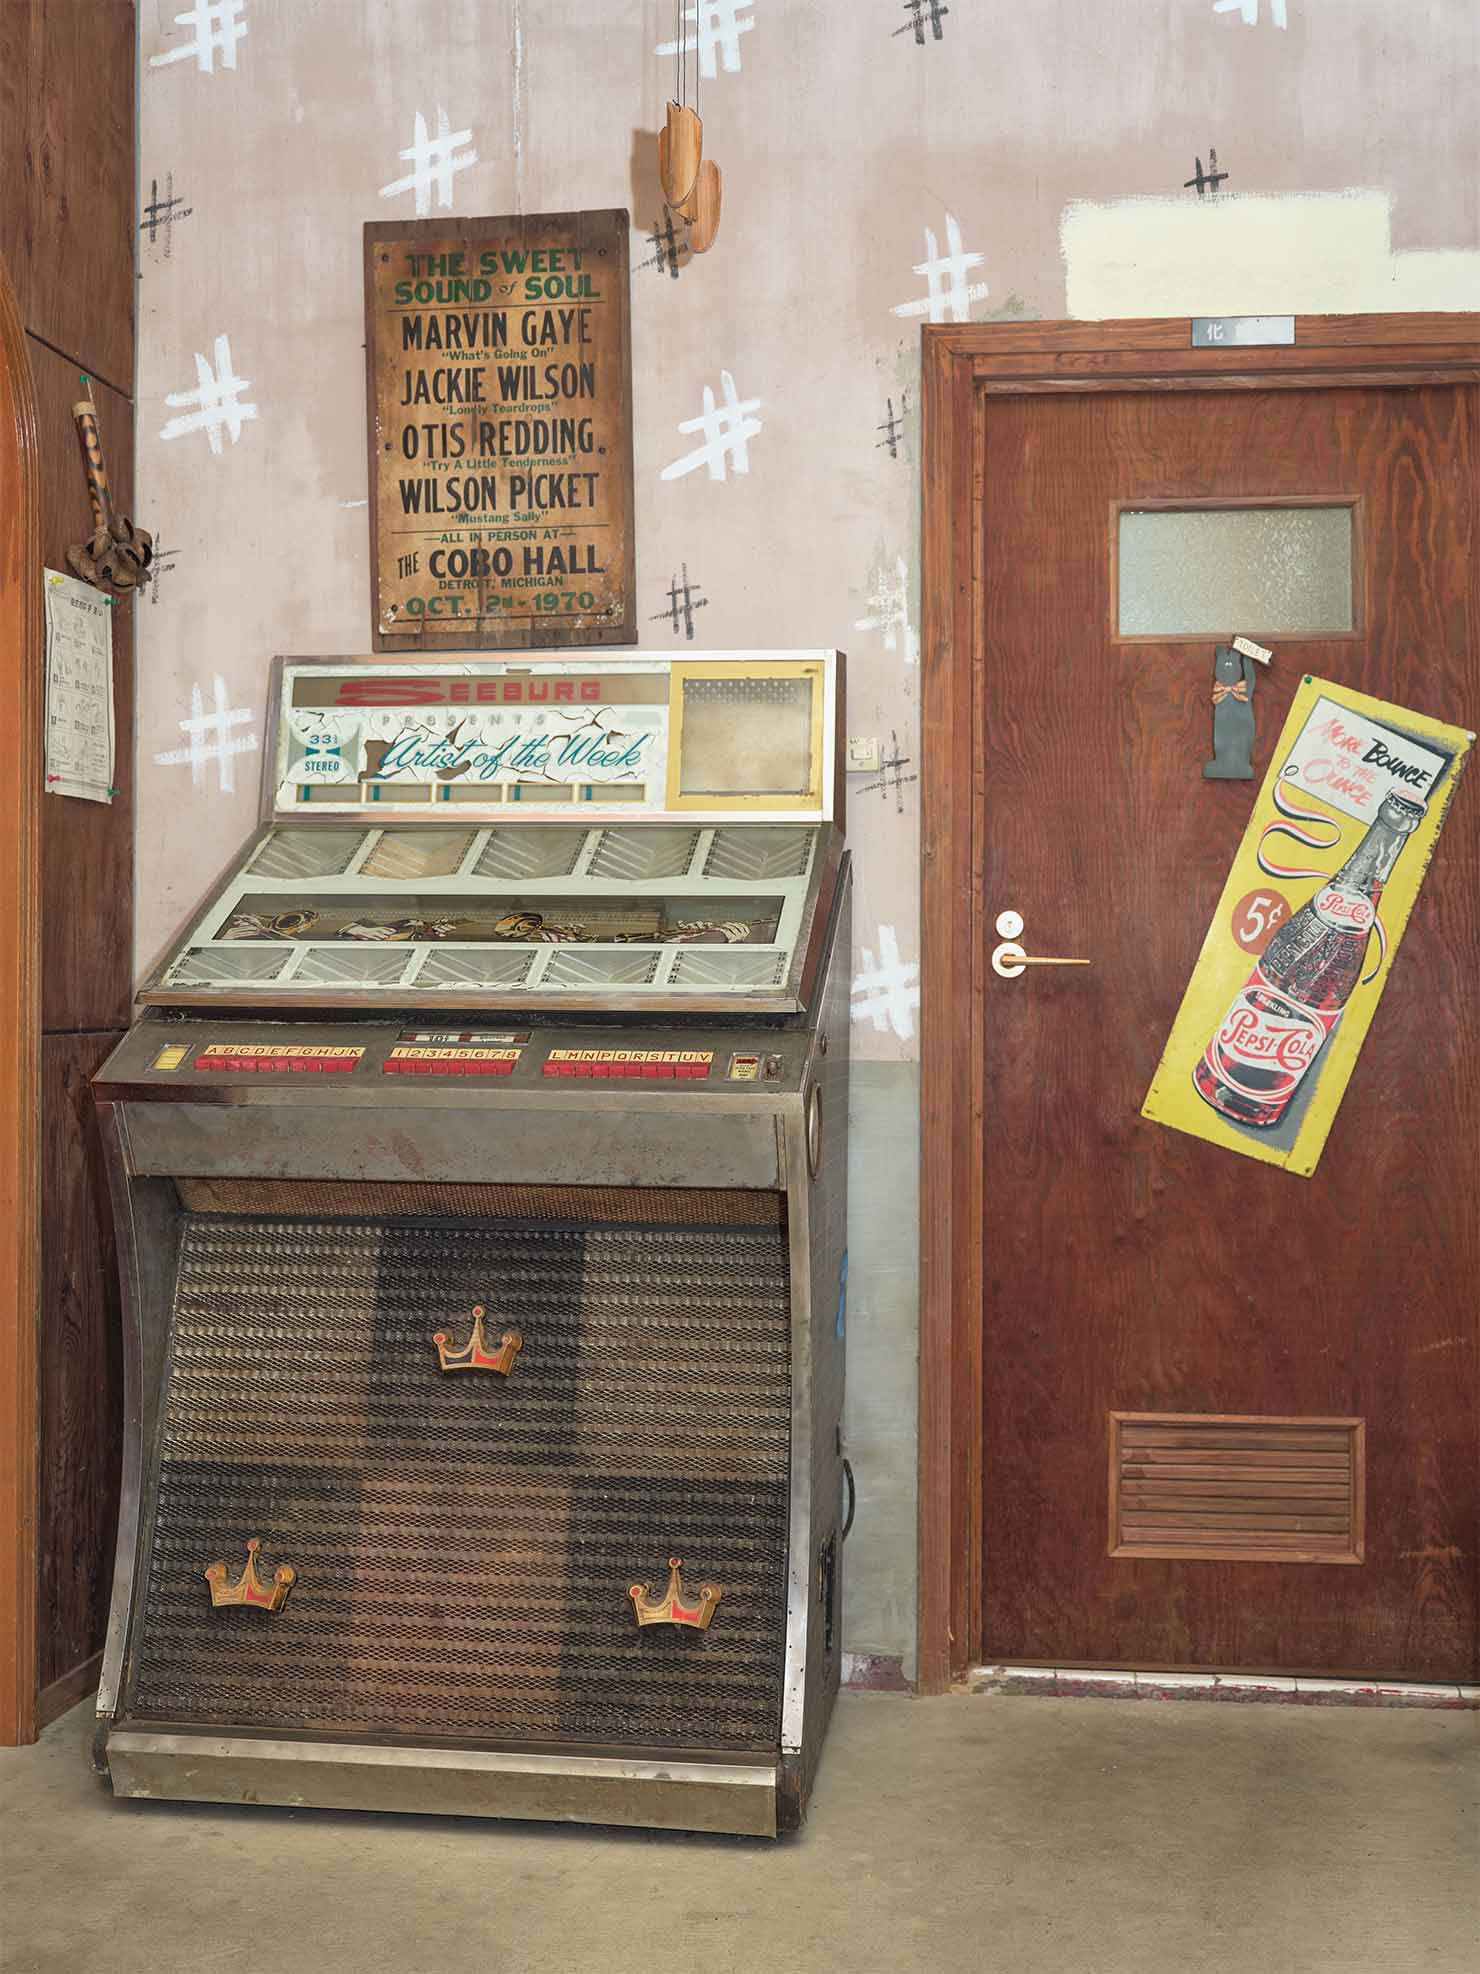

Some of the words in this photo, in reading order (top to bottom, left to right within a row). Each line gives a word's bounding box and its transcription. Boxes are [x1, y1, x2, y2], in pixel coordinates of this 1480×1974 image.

[404, 252, 466, 277] THE
[480, 247, 583, 276] SWEET
[394, 278, 492, 305] SOUND
[498, 280, 519, 296] of
[524, 273, 601, 300] SOUL
[402, 311, 507, 351] MARVIN
[521, 308, 593, 346] GAYE
[493, 349, 527, 361] Going
[400, 366, 486, 406] JACKIE
[497, 362, 595, 401] WILSON
[402, 421, 466, 460] OTIS
[479, 418, 594, 457] REDDING
[454, 460, 463, 469] A
[466, 458, 497, 470] Little
[399, 475, 497, 514] WILSON
[509, 472, 600, 510] PICKET
[440, 532, 464, 544] ALL
[469, 531, 483, 542] IN
[488, 530, 537, 541] PERSON
[543, 528, 560, 539] AT
[397, 551, 419, 580] THE
[429, 546, 513, 579] COBO
[523, 544, 606, 576] HALL
[500, 576, 564, 588] MICHIGAN
[406, 595, 472, 616] OCT.
[532, 591, 595, 612] 1970
[335, 680, 602, 708] SEEBURG
[304, 760, 340, 772] STEREO
[371, 735, 477, 779] Artist
[472, 735, 521, 780] of
[510, 735, 549, 768] the
[556, 734, 649, 768] Week
[1361, 737, 1433, 789] BOUNCE
[1302, 758, 1373, 807] OUNCE
